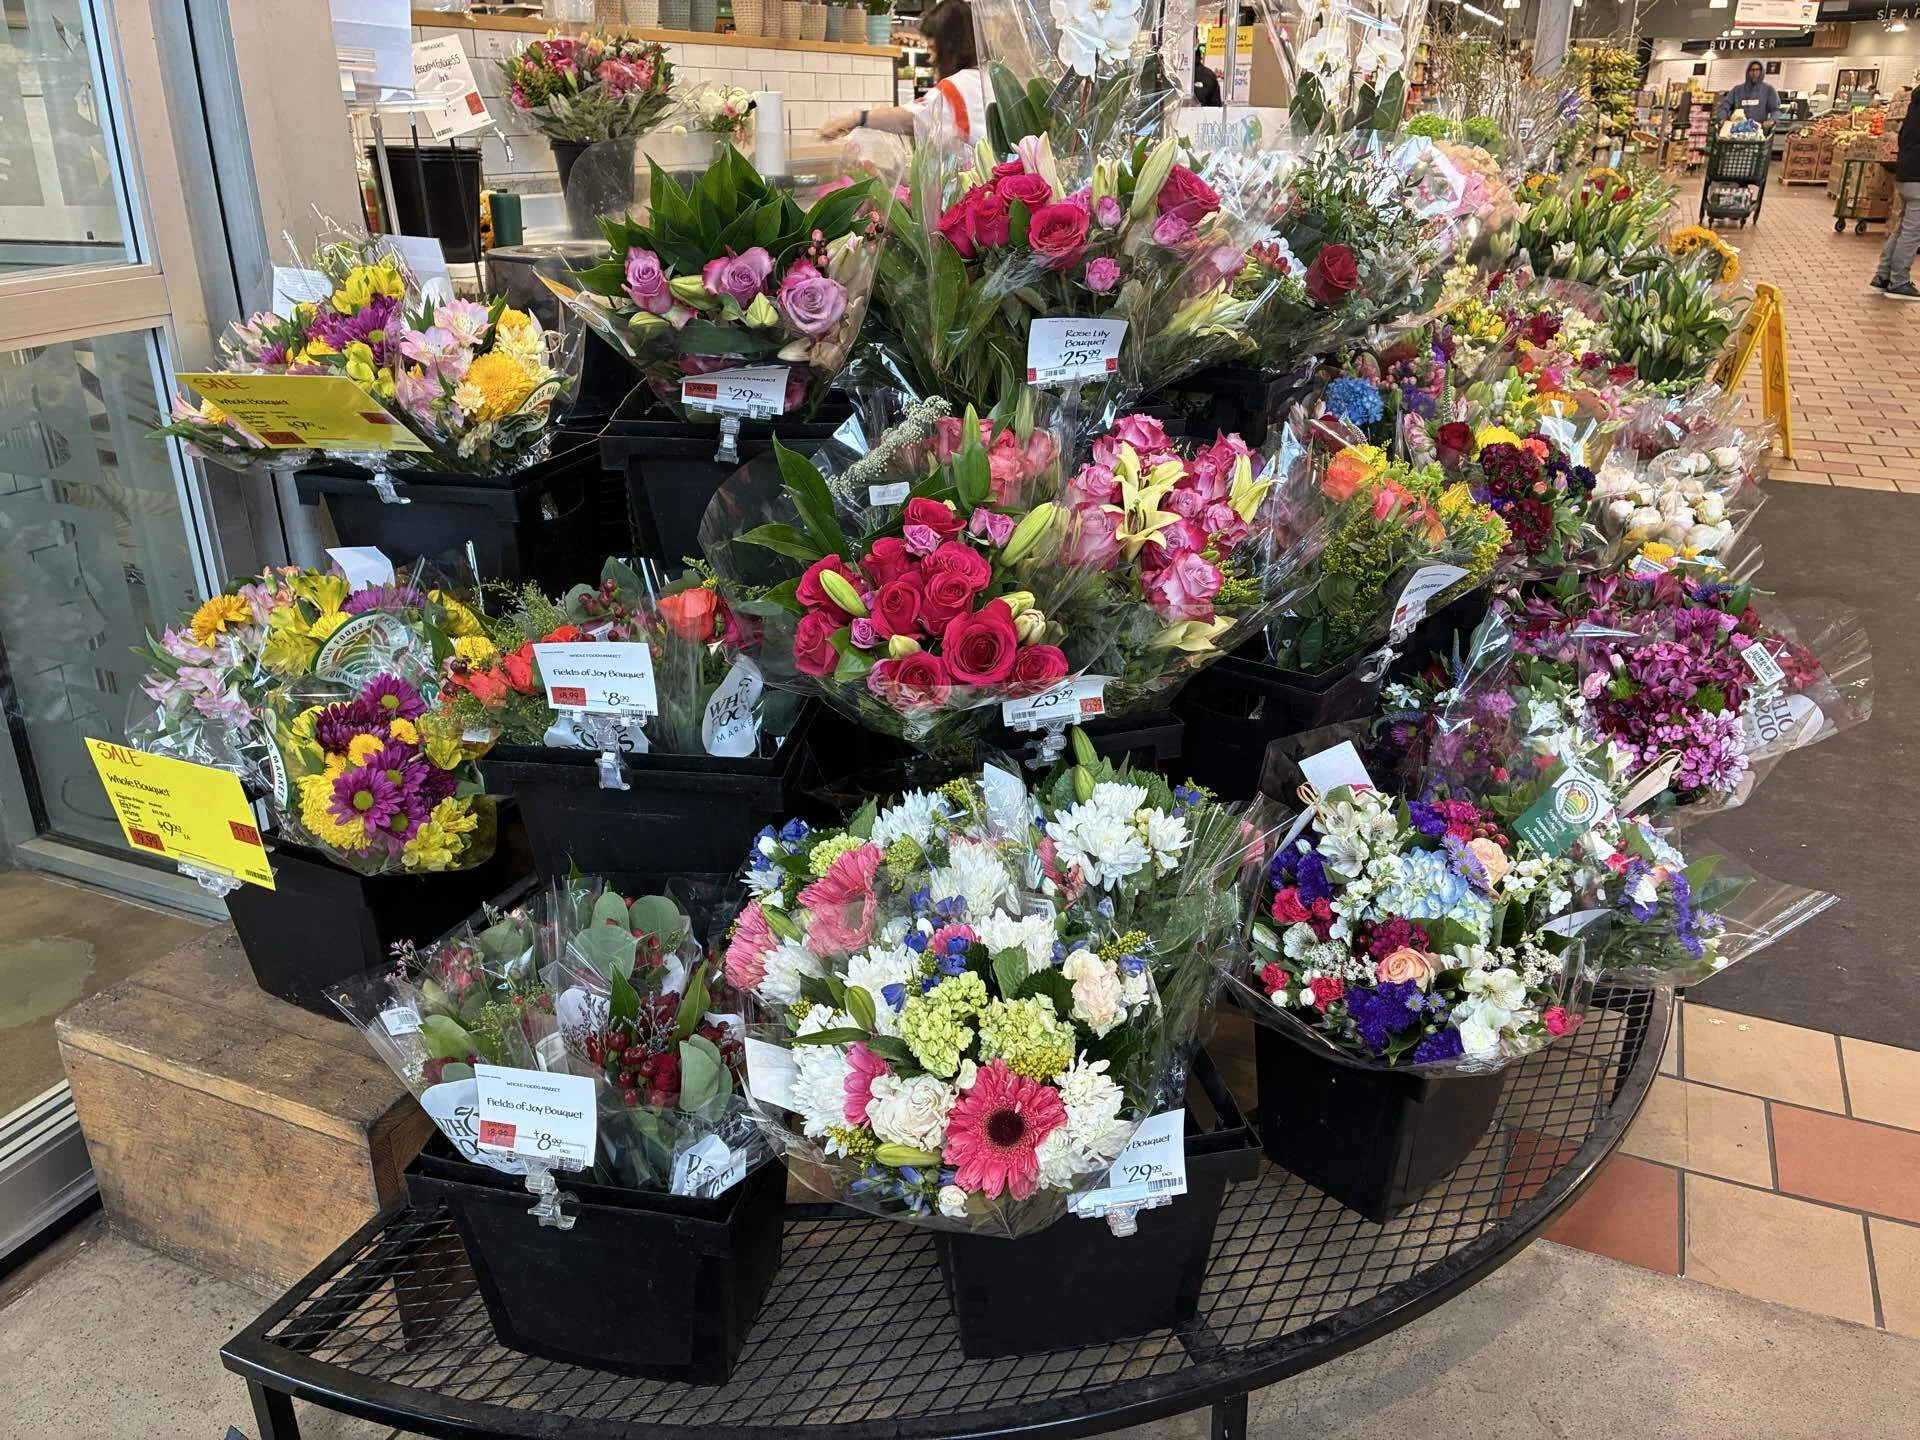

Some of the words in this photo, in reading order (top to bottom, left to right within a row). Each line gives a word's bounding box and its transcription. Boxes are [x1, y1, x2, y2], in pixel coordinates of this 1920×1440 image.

[1709, 38, 1777, 50] BUTCHER
[1065, 329, 1092, 338] Rose
[1093, 330, 1110, 339] Lily
[1064, 339, 1106, 348] Bouquet
[193, 377, 249, 391] SALE
[553, 668, 580, 676] Fields
[581, 668, 591, 677] of
[591, 669, 607, 679] Joy
[608, 670, 646, 679] Bouquet
[716, 719, 753, 743] MARKE
[96, 742, 143, 767] SALE
[106, 773, 134, 790] Whole
[133, 780, 171, 797] Bouquet
[487, 1097, 514, 1109] Fields
[515, 1102, 527, 1111] of
[526, 1103, 544, 1115] Joy
[545, 1106, 584, 1120] Bouquet
[1132, 1134, 1172, 1149] Bouquet
